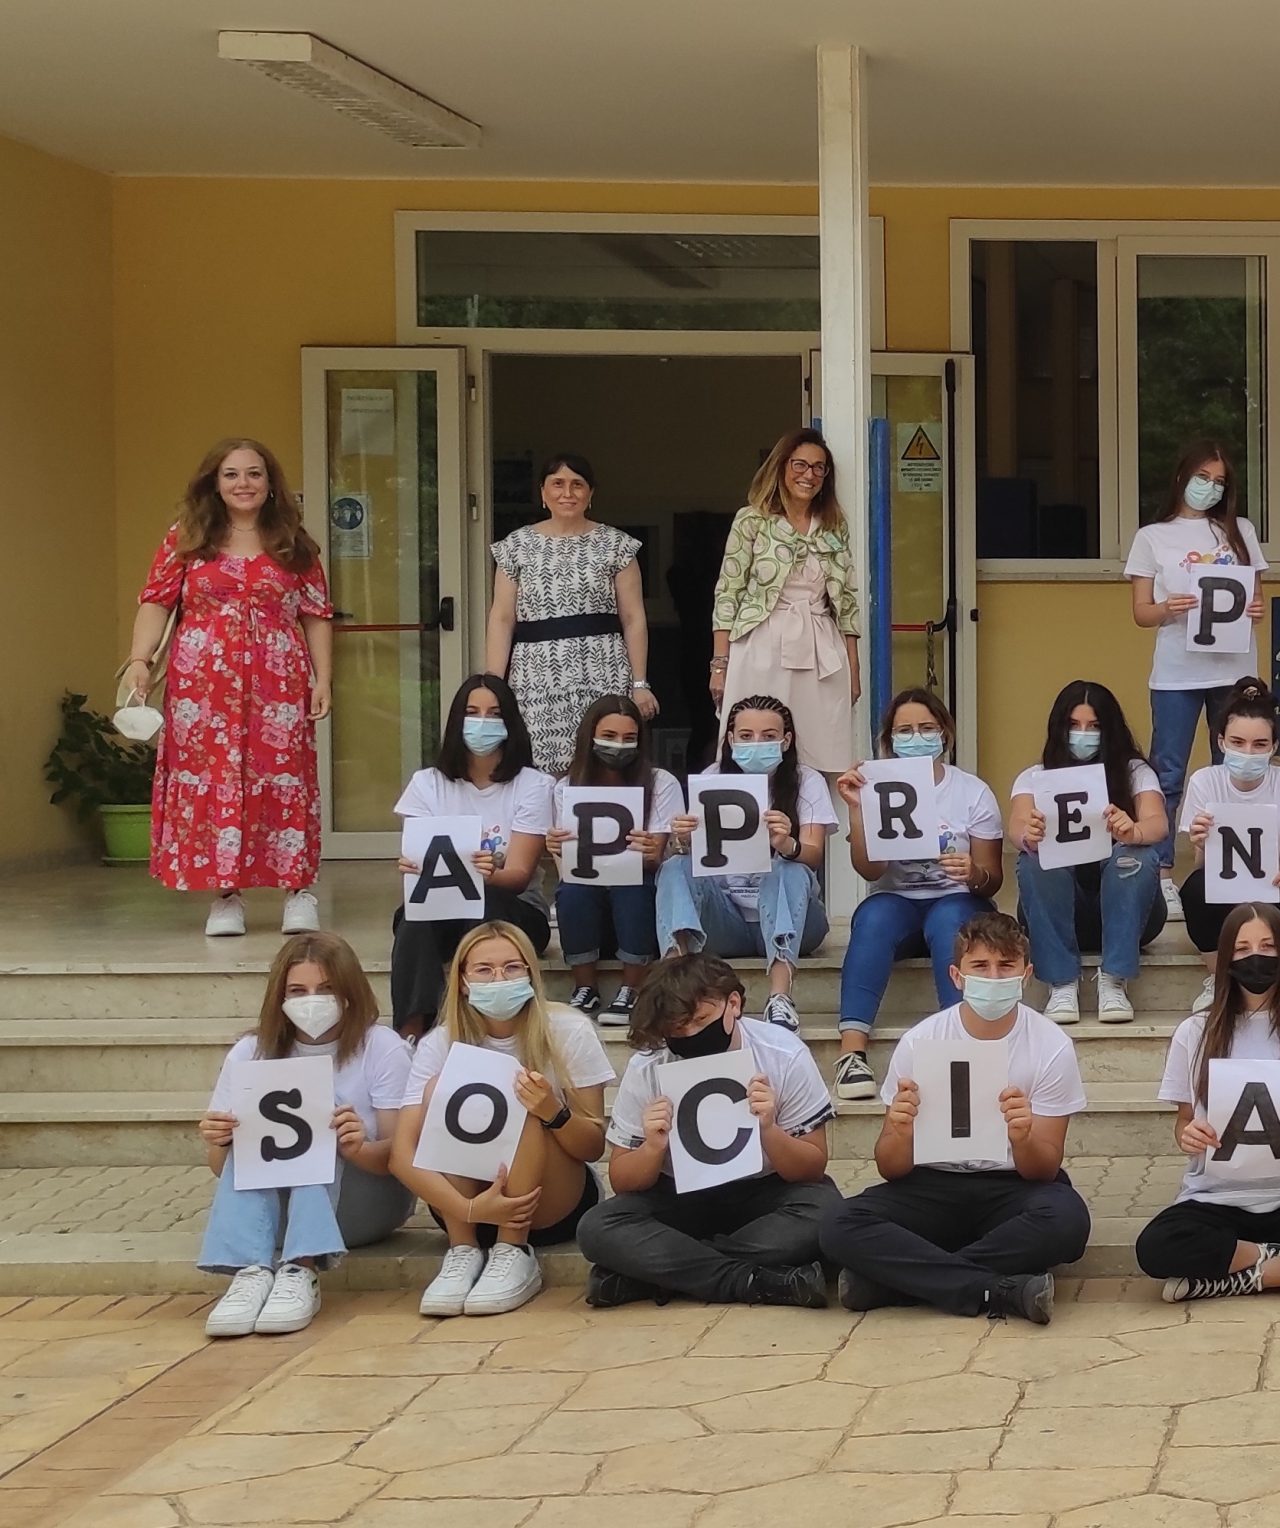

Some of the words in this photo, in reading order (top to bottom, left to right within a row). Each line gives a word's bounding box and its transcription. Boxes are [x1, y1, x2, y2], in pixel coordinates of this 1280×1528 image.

[1193, 577, 1246, 645] P
[409, 835, 481, 903] A
[571, 802, 634, 879] P
[699, 789, 759, 867] P
[874, 782, 923, 839] R
[1054, 792, 1091, 843] E
[1218, 826, 1265, 879] N
[259, 1089, 312, 1162] S
[445, 1083, 508, 1144] O
[677, 1078, 753, 1165] C
[951, 1061, 970, 1138] I
